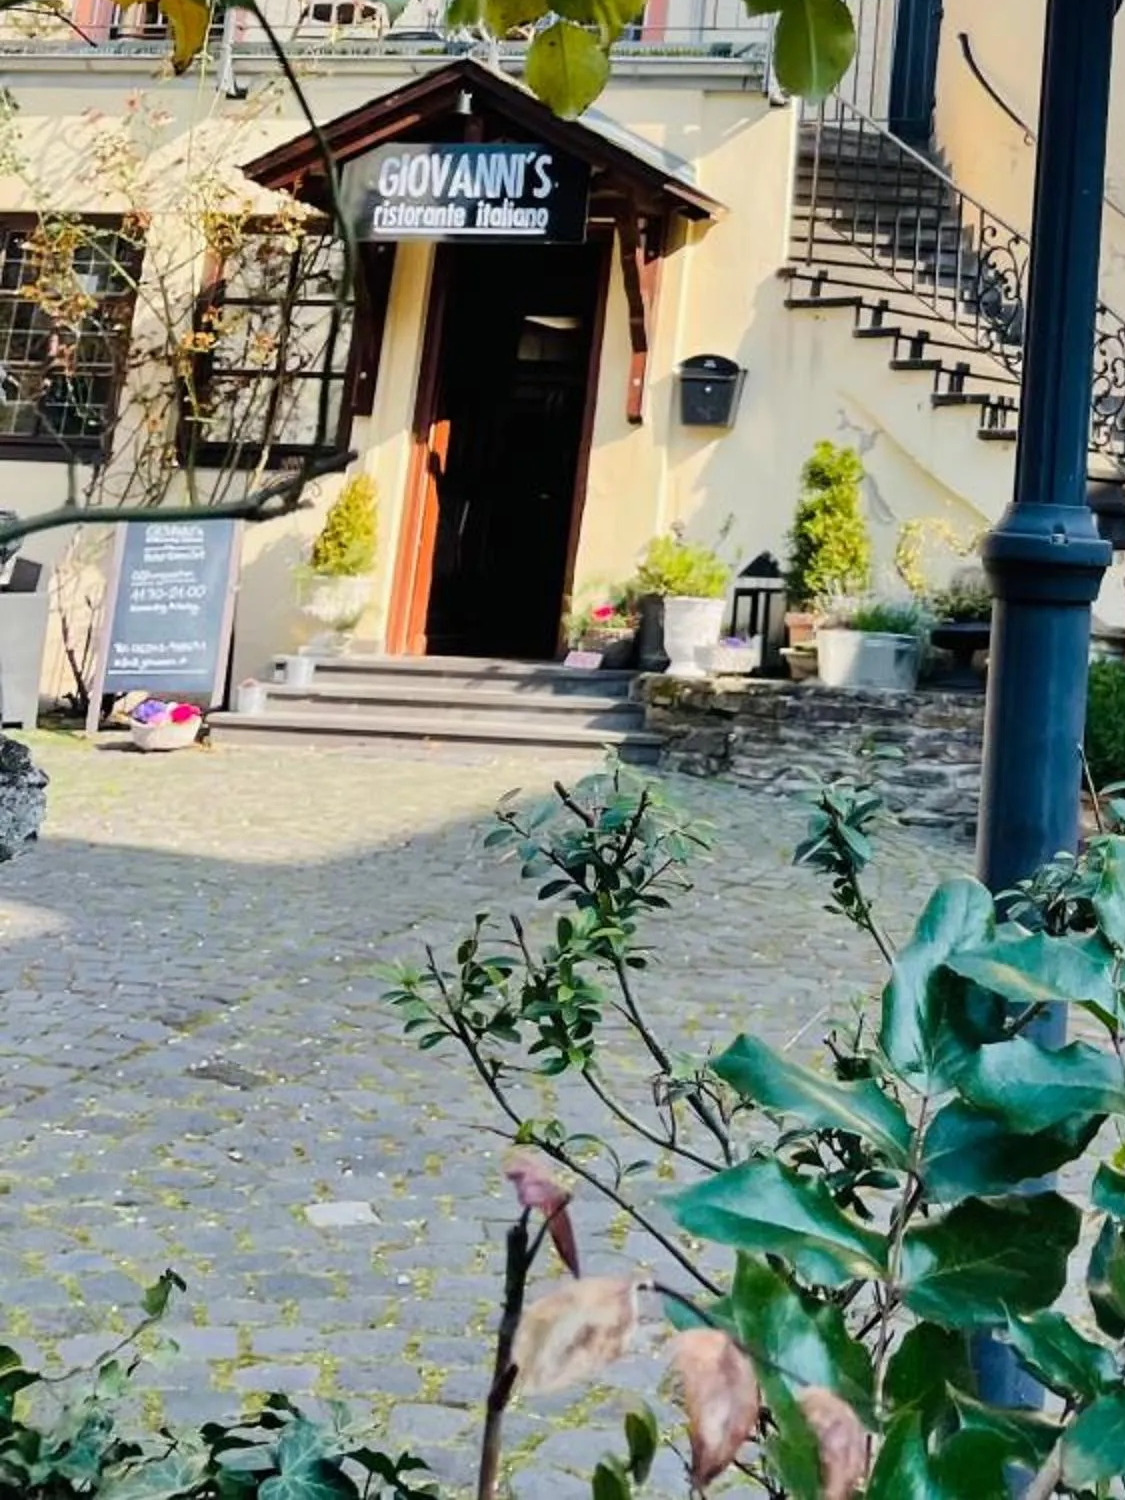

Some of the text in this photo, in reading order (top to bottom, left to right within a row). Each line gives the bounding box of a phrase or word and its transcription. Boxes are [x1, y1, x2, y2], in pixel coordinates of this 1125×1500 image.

[378, 152, 553, 199] GIOVANNI'S
[373, 198, 549, 228] ristorante italiano
